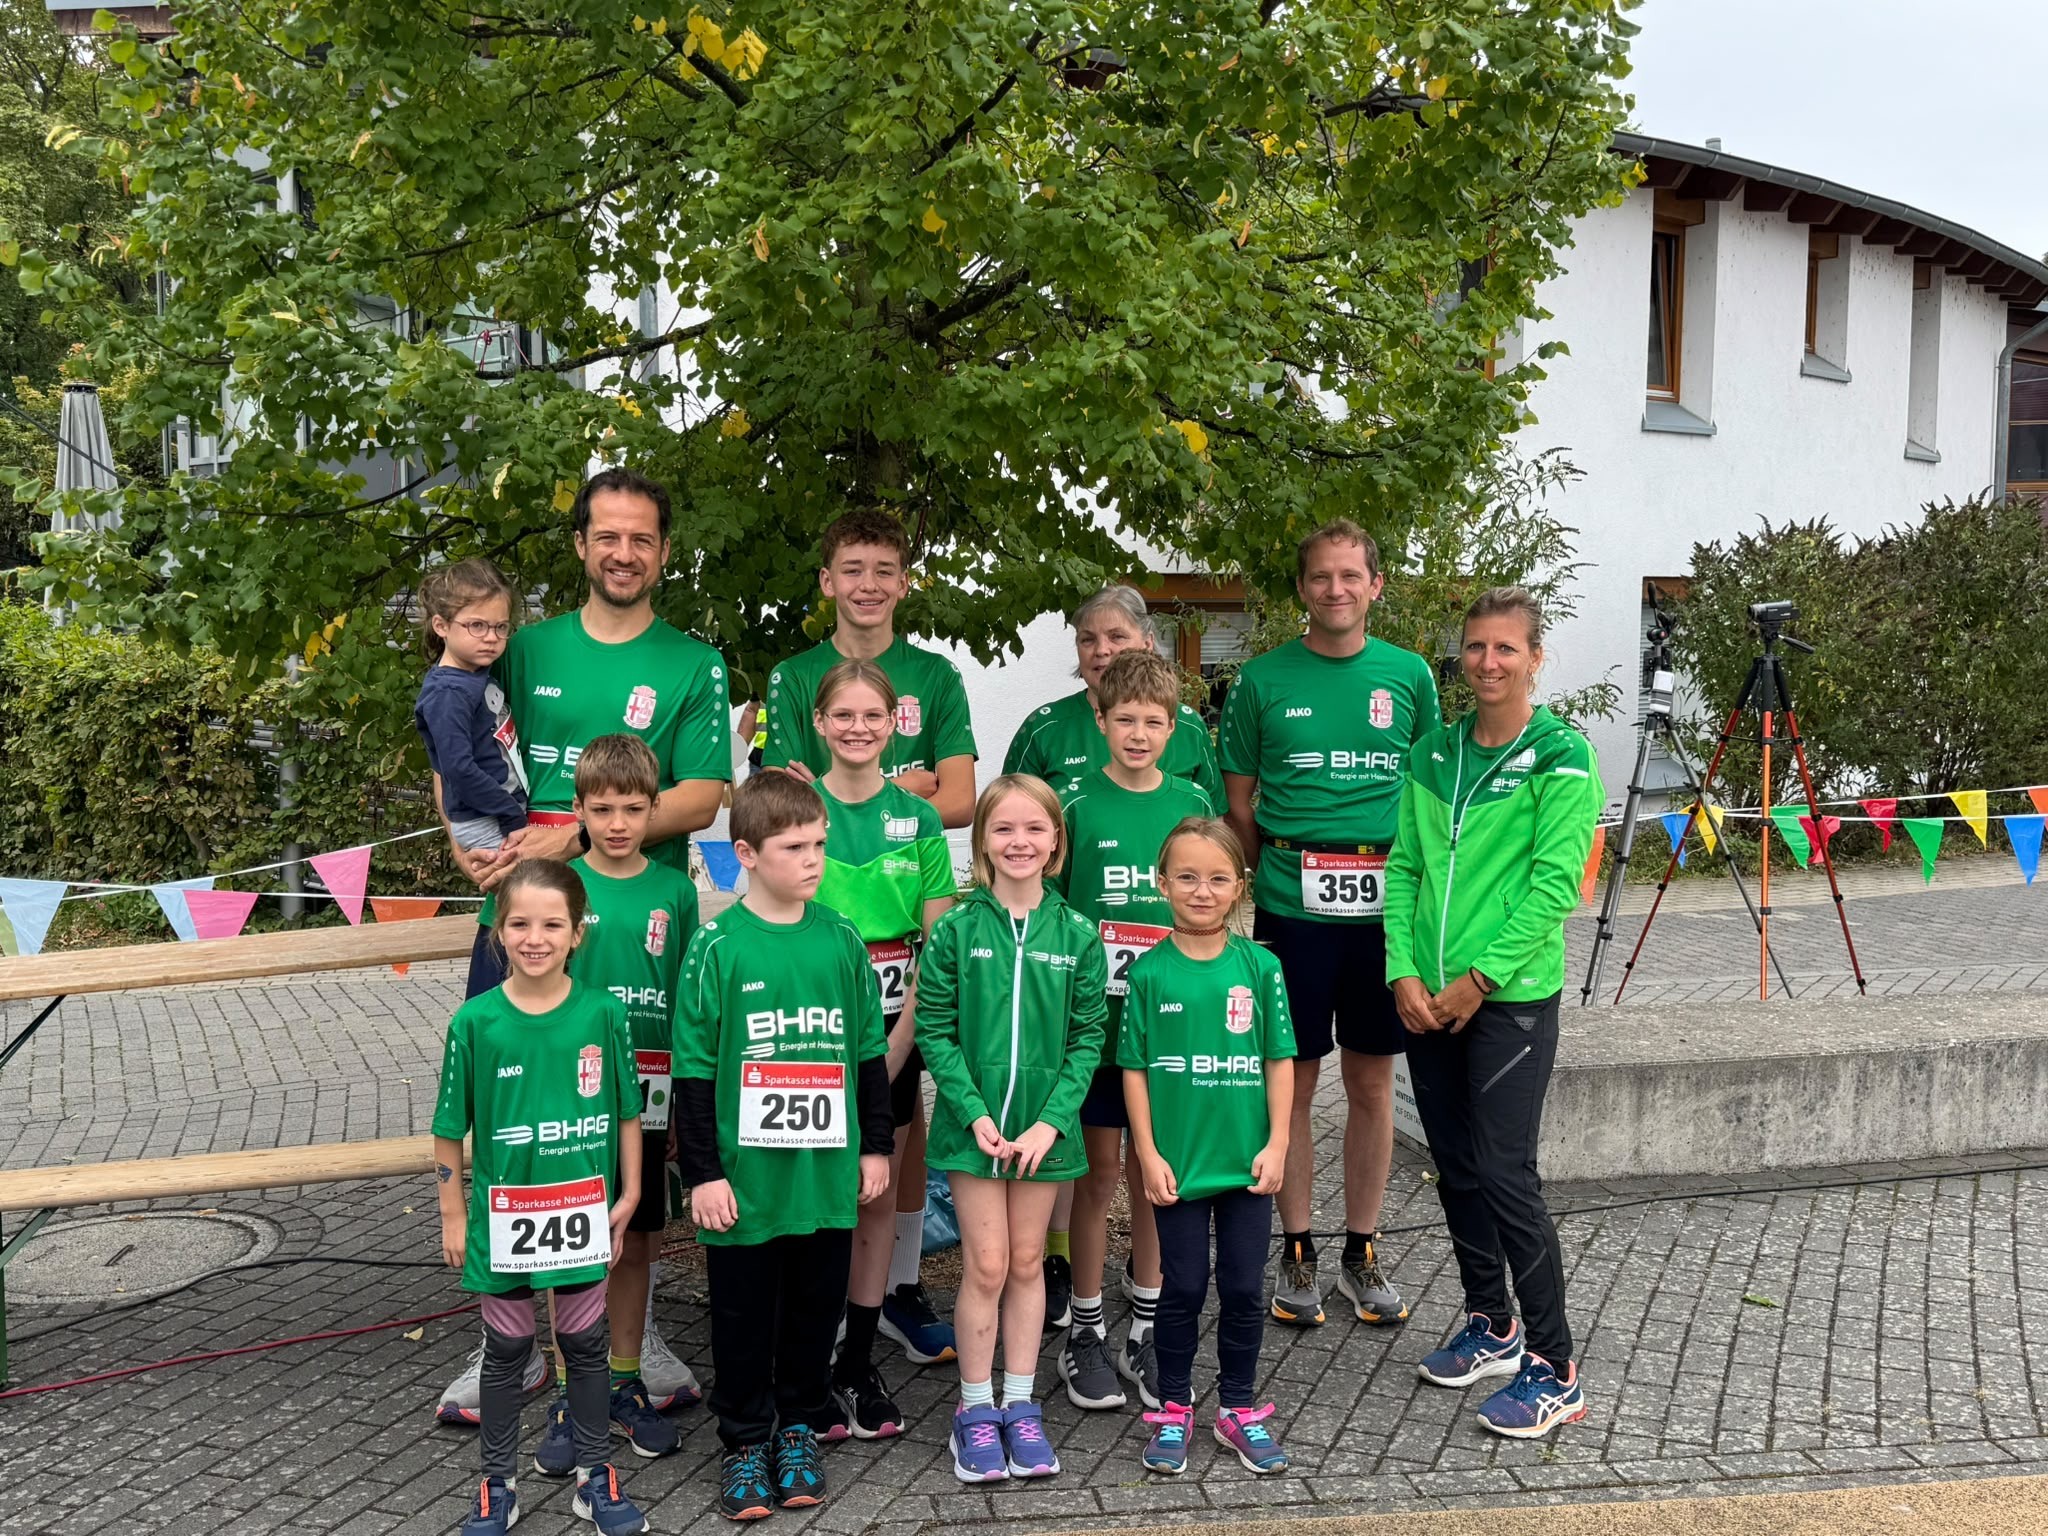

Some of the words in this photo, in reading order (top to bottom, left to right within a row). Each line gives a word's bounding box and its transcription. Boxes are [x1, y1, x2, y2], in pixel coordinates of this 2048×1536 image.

[534, 685, 562, 697] JAKO
[1285, 707, 1312, 717] JAKO
[1064, 756, 1087, 765] JAKO
[1331, 751, 1401, 770] BHAG
[1432, 752, 1444, 762] KO
[1330, 772, 1357, 781] Energie
[1492, 778, 1521, 787] BHA
[1098, 839, 1118, 848] JAKO
[884, 860, 919, 870] BHAG
[1319, 860, 1357, 868] Sparkasse
[1103, 865, 1156, 889] BH
[1318, 874, 1378, 903] 359
[1132, 894, 1158, 903] Energie
[1305, 906, 1384, 914] www.sparkasse-neuwied
[584, 915, 600, 924] KO
[1118, 933, 1158, 945] Sparkasse
[878, 948, 910, 959] Neuwied
[970, 948, 993, 958] JAKO
[742, 981, 765, 992] JAKO
[1160, 1002, 1183, 1013] JAKO
[746, 1007, 844, 1040] BHAG
[780, 1041, 808, 1052] Energie
[637, 1062, 668, 1071] Neuwied
[1192, 1055, 1261, 1074] BHAG
[497, 1065, 523, 1078] JAKO
[764, 1075, 810, 1086] Sparkasse
[812, 1075, 840, 1085] Neuwied
[1192, 1078, 1219, 1088] Energie
[760, 1093, 831, 1131] 250
[538, 1114, 610, 1142] BHAG
[740, 1135, 845, 1145] www.sparkasse-neuwied.de
[539, 1146, 570, 1156] Energie
[571, 1143, 581, 1152] mit
[512, 1199, 562, 1211] Sparkasse
[563, 1190, 601, 1205] Neuwied
[511, 1212, 591, 1255] 249
[492, 1251, 610, 1270] www.sparkasse-neuwied.de
